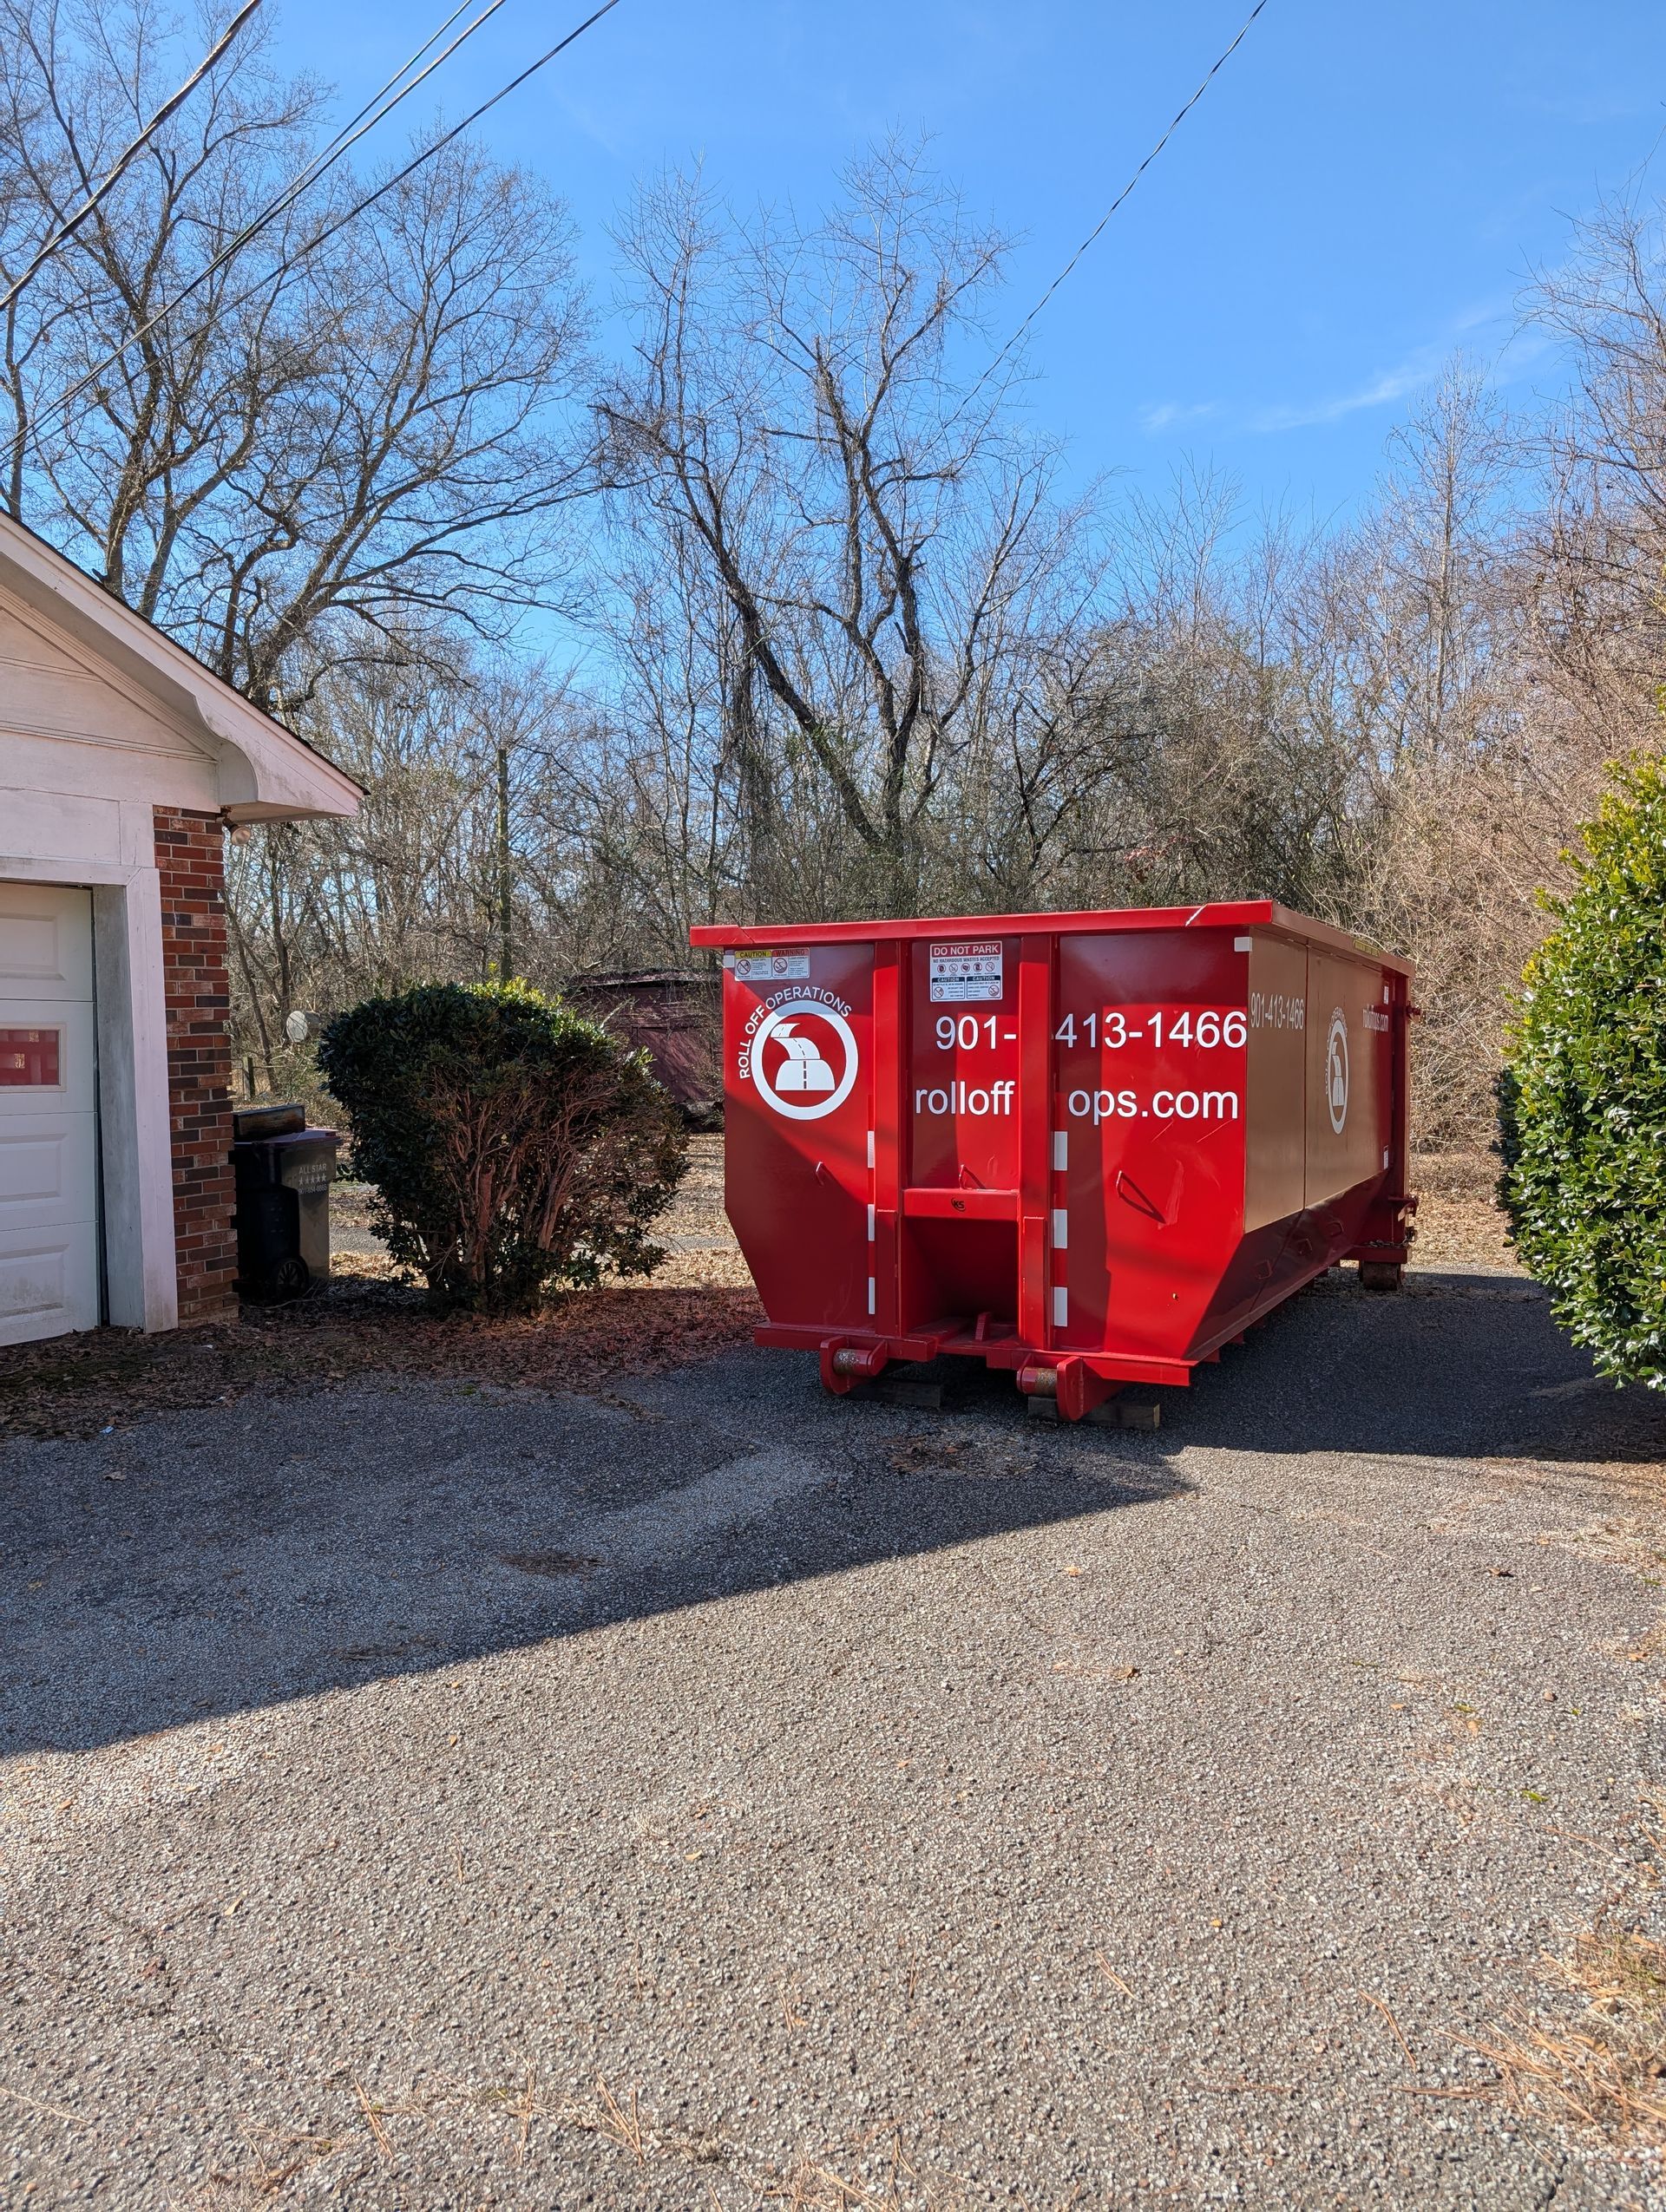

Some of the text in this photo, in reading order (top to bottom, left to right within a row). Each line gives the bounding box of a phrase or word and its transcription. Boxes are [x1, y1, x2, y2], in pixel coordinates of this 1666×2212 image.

[934, 945, 999, 956] DO NOT PARK
[1250, 991, 1304, 1030] 901-413-1466
[738, 986, 852, 1079] ROLL OFF OPERATIONS
[935, 1011, 1247, 1050] 901- 413-1466
[915, 1080, 1238, 1126] rolloff ops.com
[298, 1163, 327, 1175] ALL STAR
